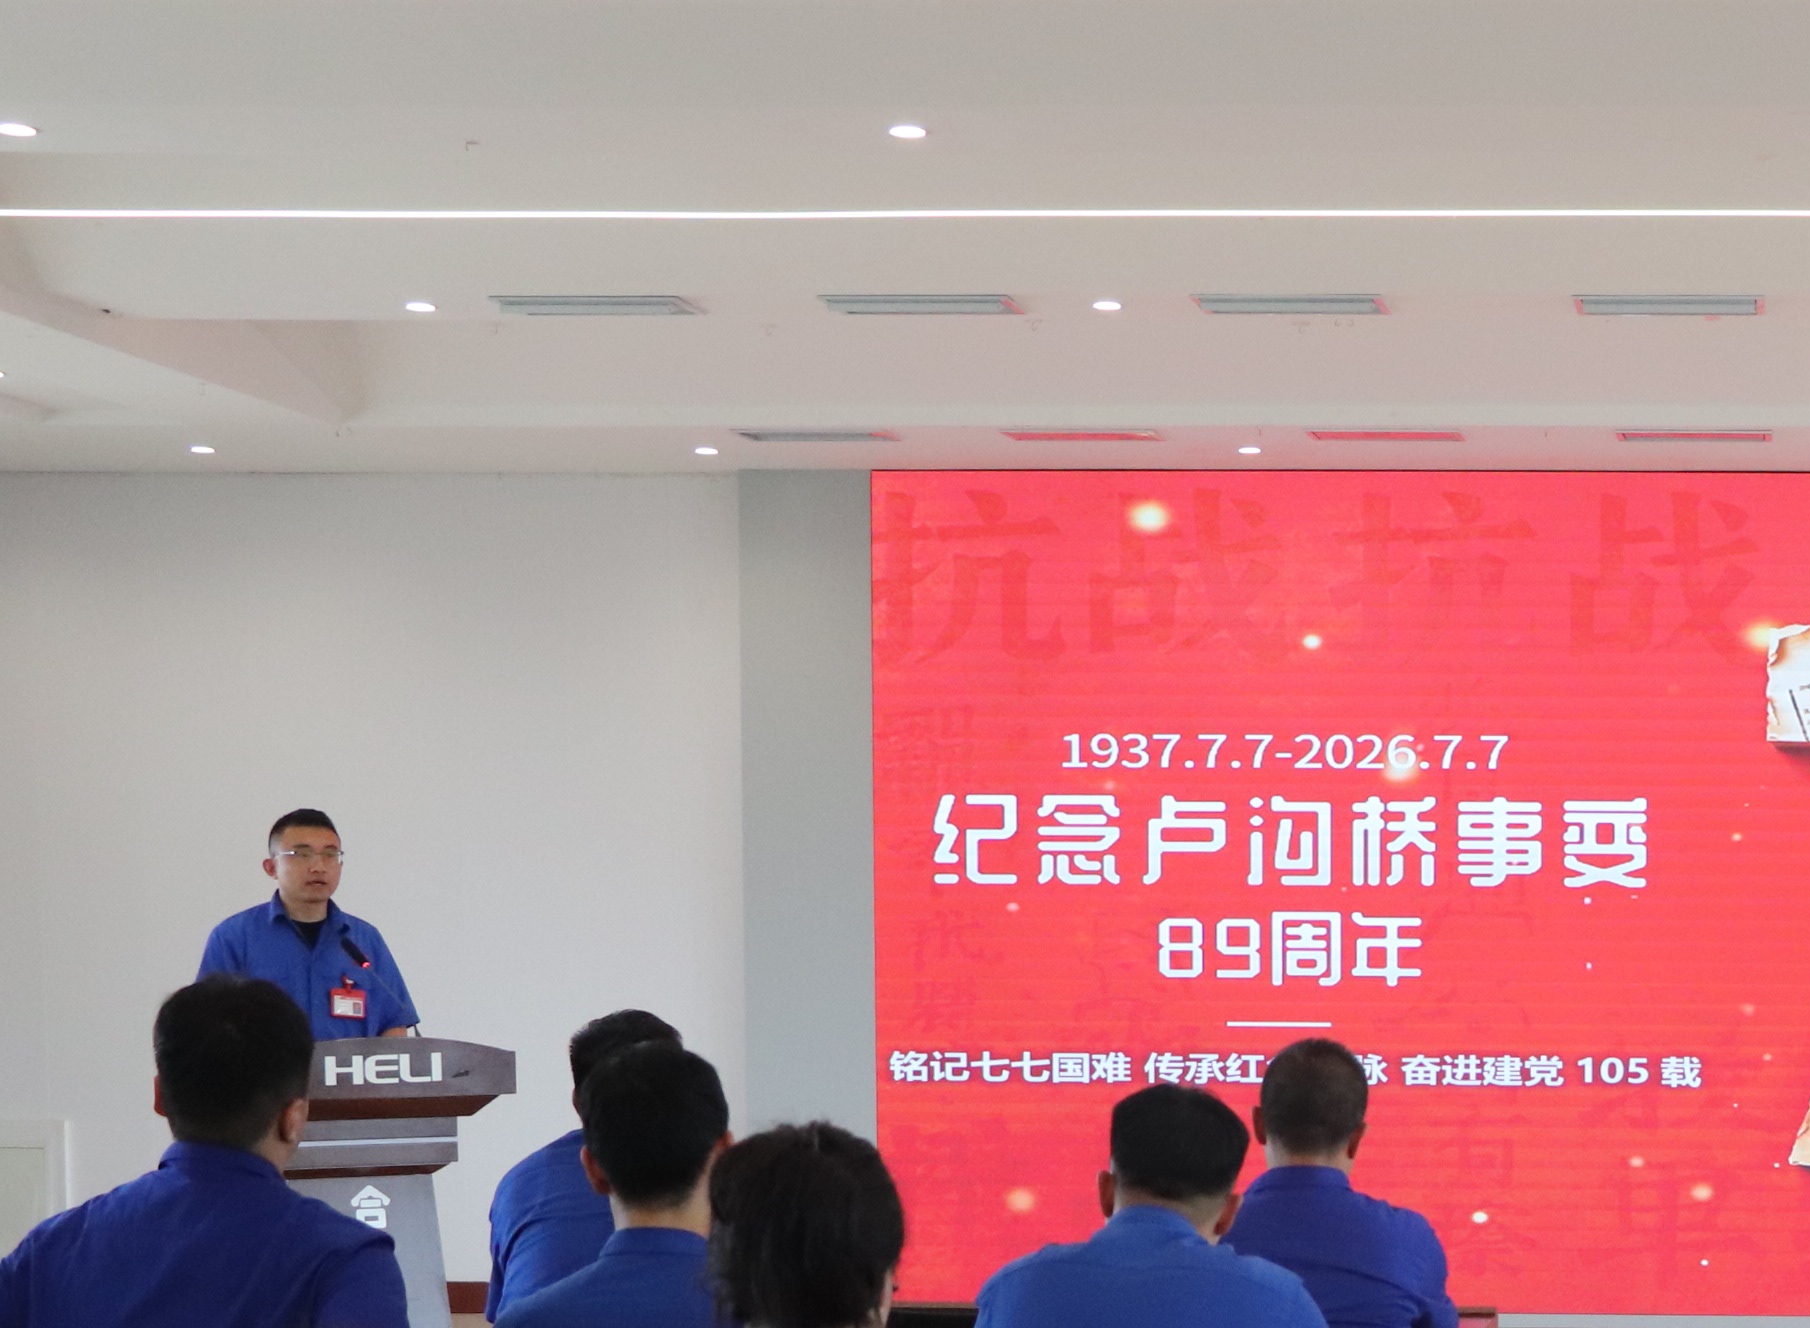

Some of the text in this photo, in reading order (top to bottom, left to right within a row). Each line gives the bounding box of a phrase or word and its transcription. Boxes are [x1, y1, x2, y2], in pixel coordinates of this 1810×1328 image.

[1061, 733, 1509, 771] 1937.7.7-2026.7.7
[933, 794, 1648, 889] 纪念卢沟桥事变
[1158, 911, 1423, 987] 89周年
[324, 1052, 443, 1086] HELI
[889, 1050, 1702, 1088] 铭记七七国难 传承红脉 奋进建党 105 载
[351, 1184, 391, 1229] 合
